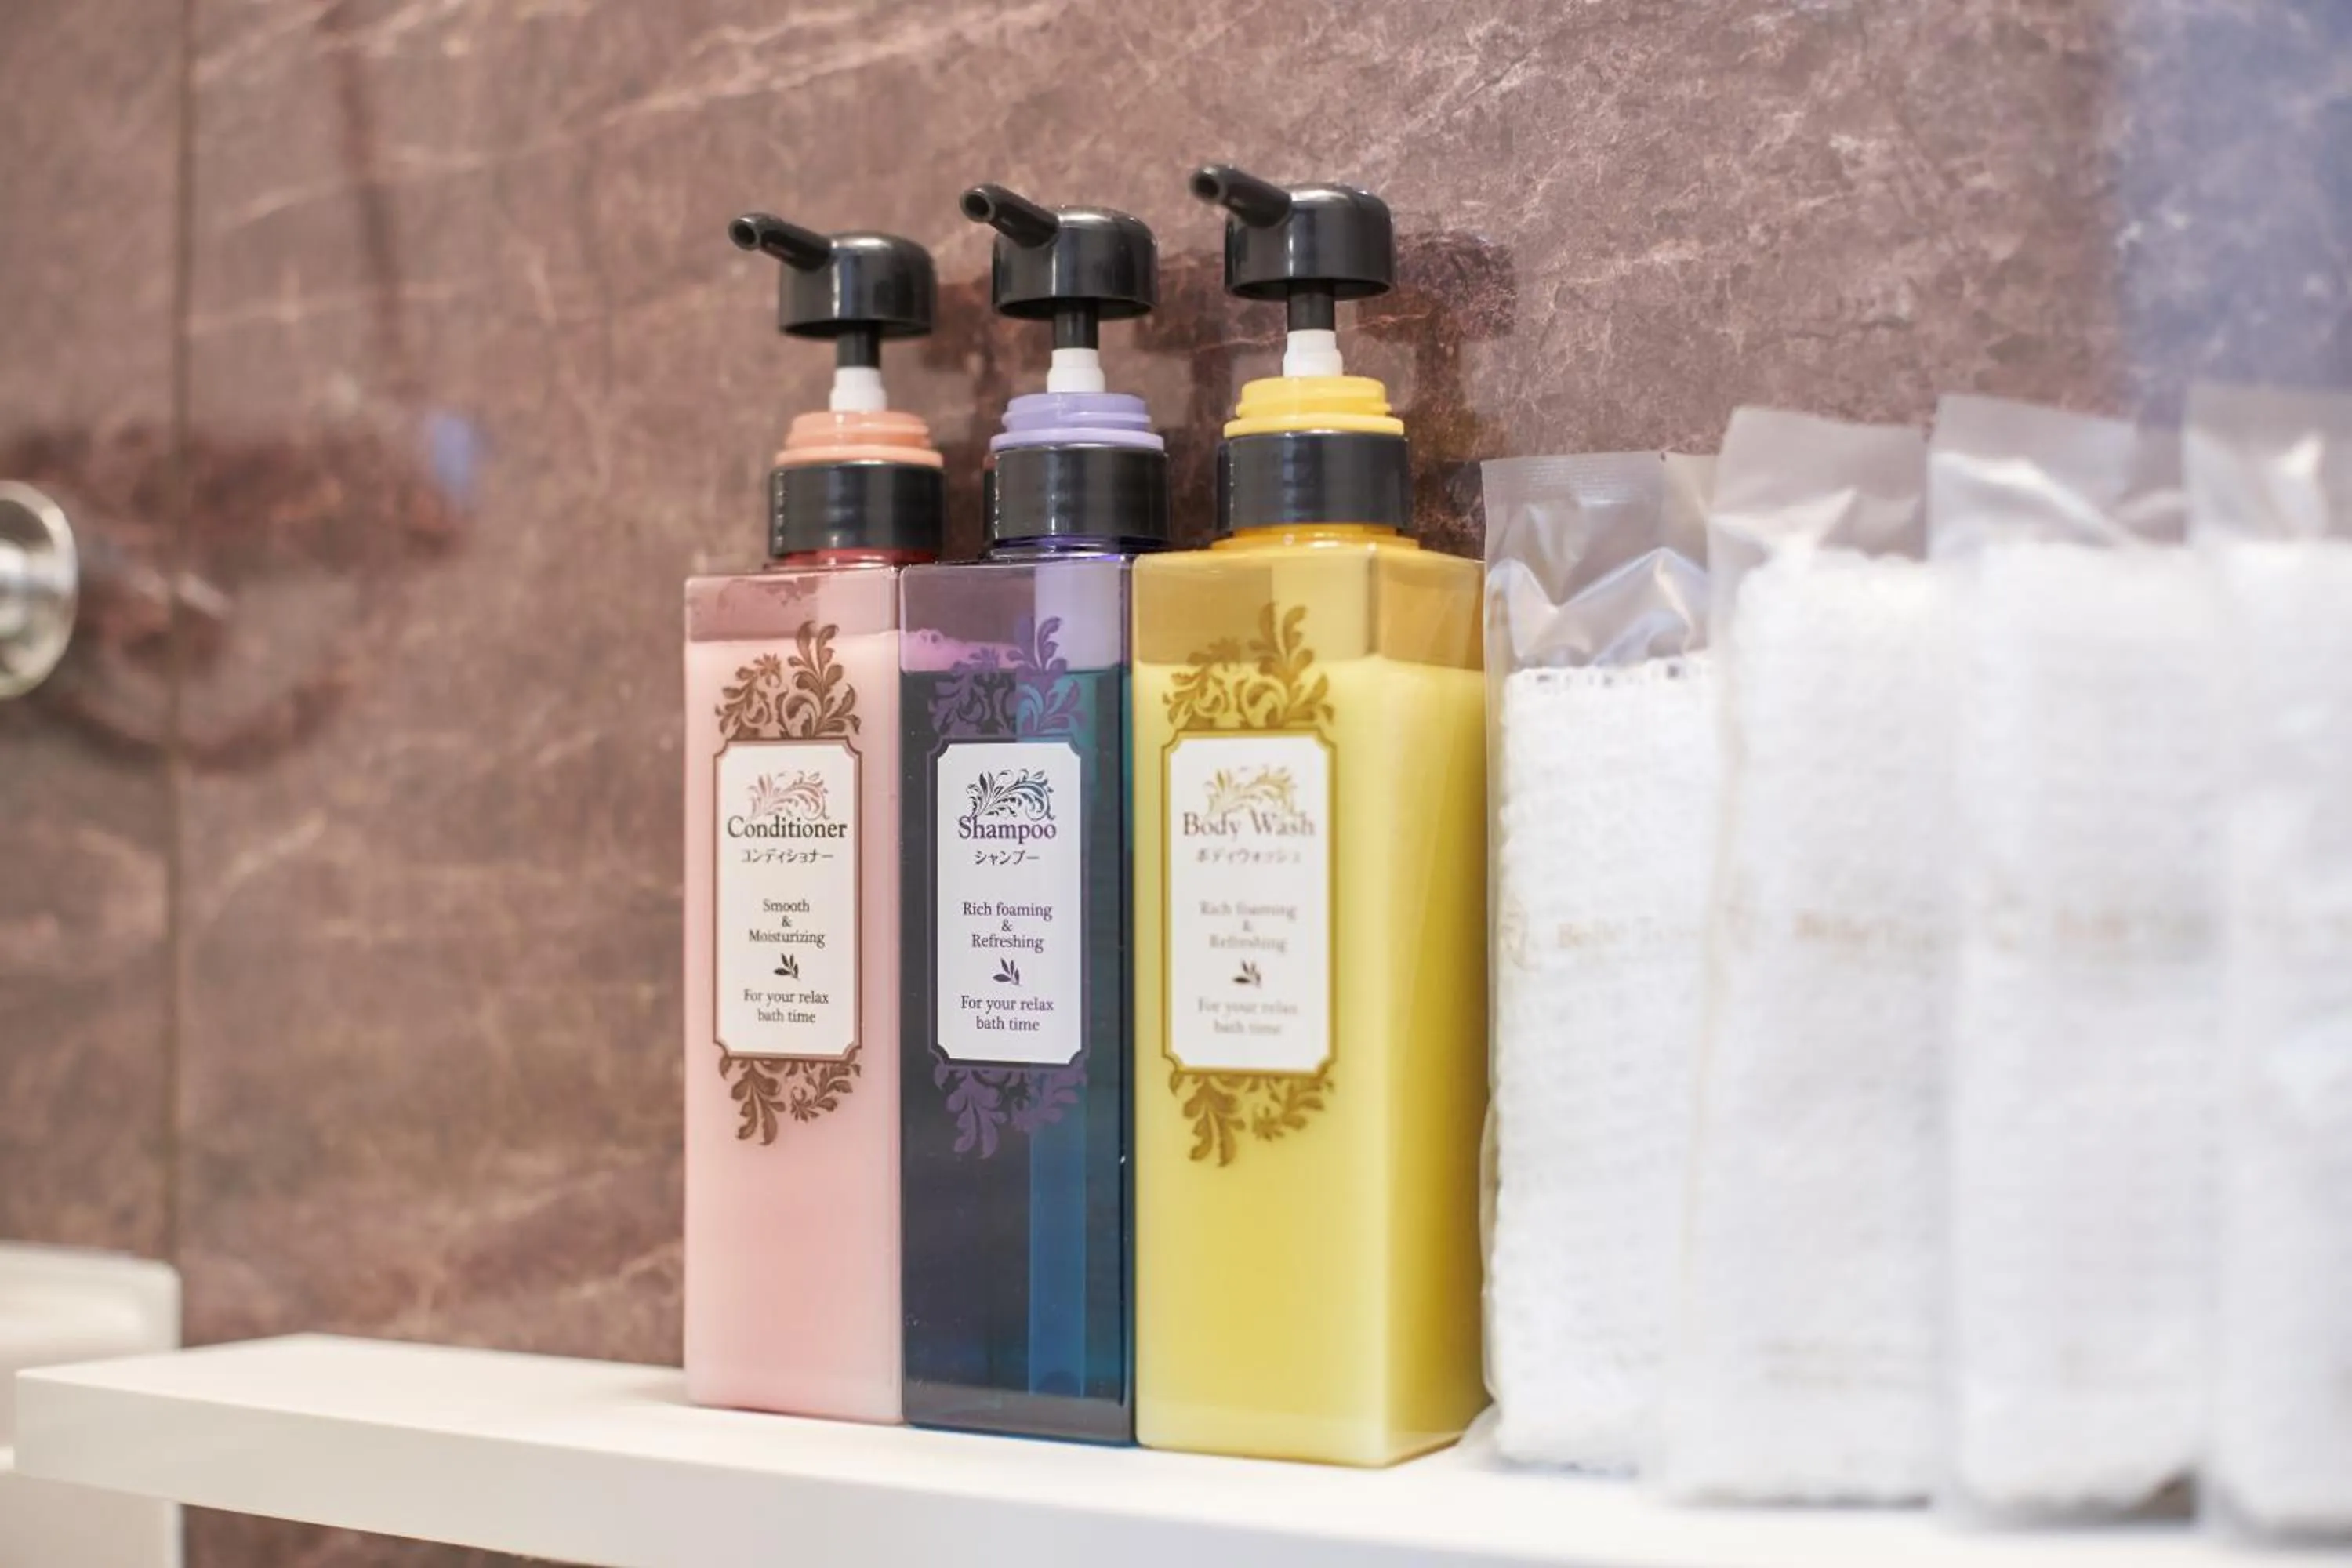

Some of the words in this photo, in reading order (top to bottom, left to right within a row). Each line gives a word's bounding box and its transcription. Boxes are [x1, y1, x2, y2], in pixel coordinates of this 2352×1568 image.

[728, 815, 848, 839] Conditioner
[958, 815, 1057, 844] Shampoo
[1182, 812, 1241, 840] Body
[1248, 811, 1316, 837] Wash
[741, 848, 834, 863] コンディショナー
[974, 850, 1040, 866] シャンプー
[763, 899, 810, 913] Smooth
[963, 902, 993, 916] Rich
[996, 902, 1053, 921] foaming
[1200, 901, 1232, 916] Rich
[782, 916, 792, 927] &
[1001, 920, 1013, 932] &
[748, 930, 826, 949] Moisturizing
[971, 934, 1044, 953] Refreshing
[743, 989, 764, 1004] For
[766, 991, 796, 1007] your
[798, 989, 829, 1004] relax
[960, 995, 982, 1009] For
[985, 998, 1017, 1014] your
[1020, 996, 1054, 1011] relax
[757, 1008, 784, 1023] bath
[787, 1008, 816, 1024] time
[975, 1015, 1004, 1030] bath
[1009, 1016, 1040, 1031] time
